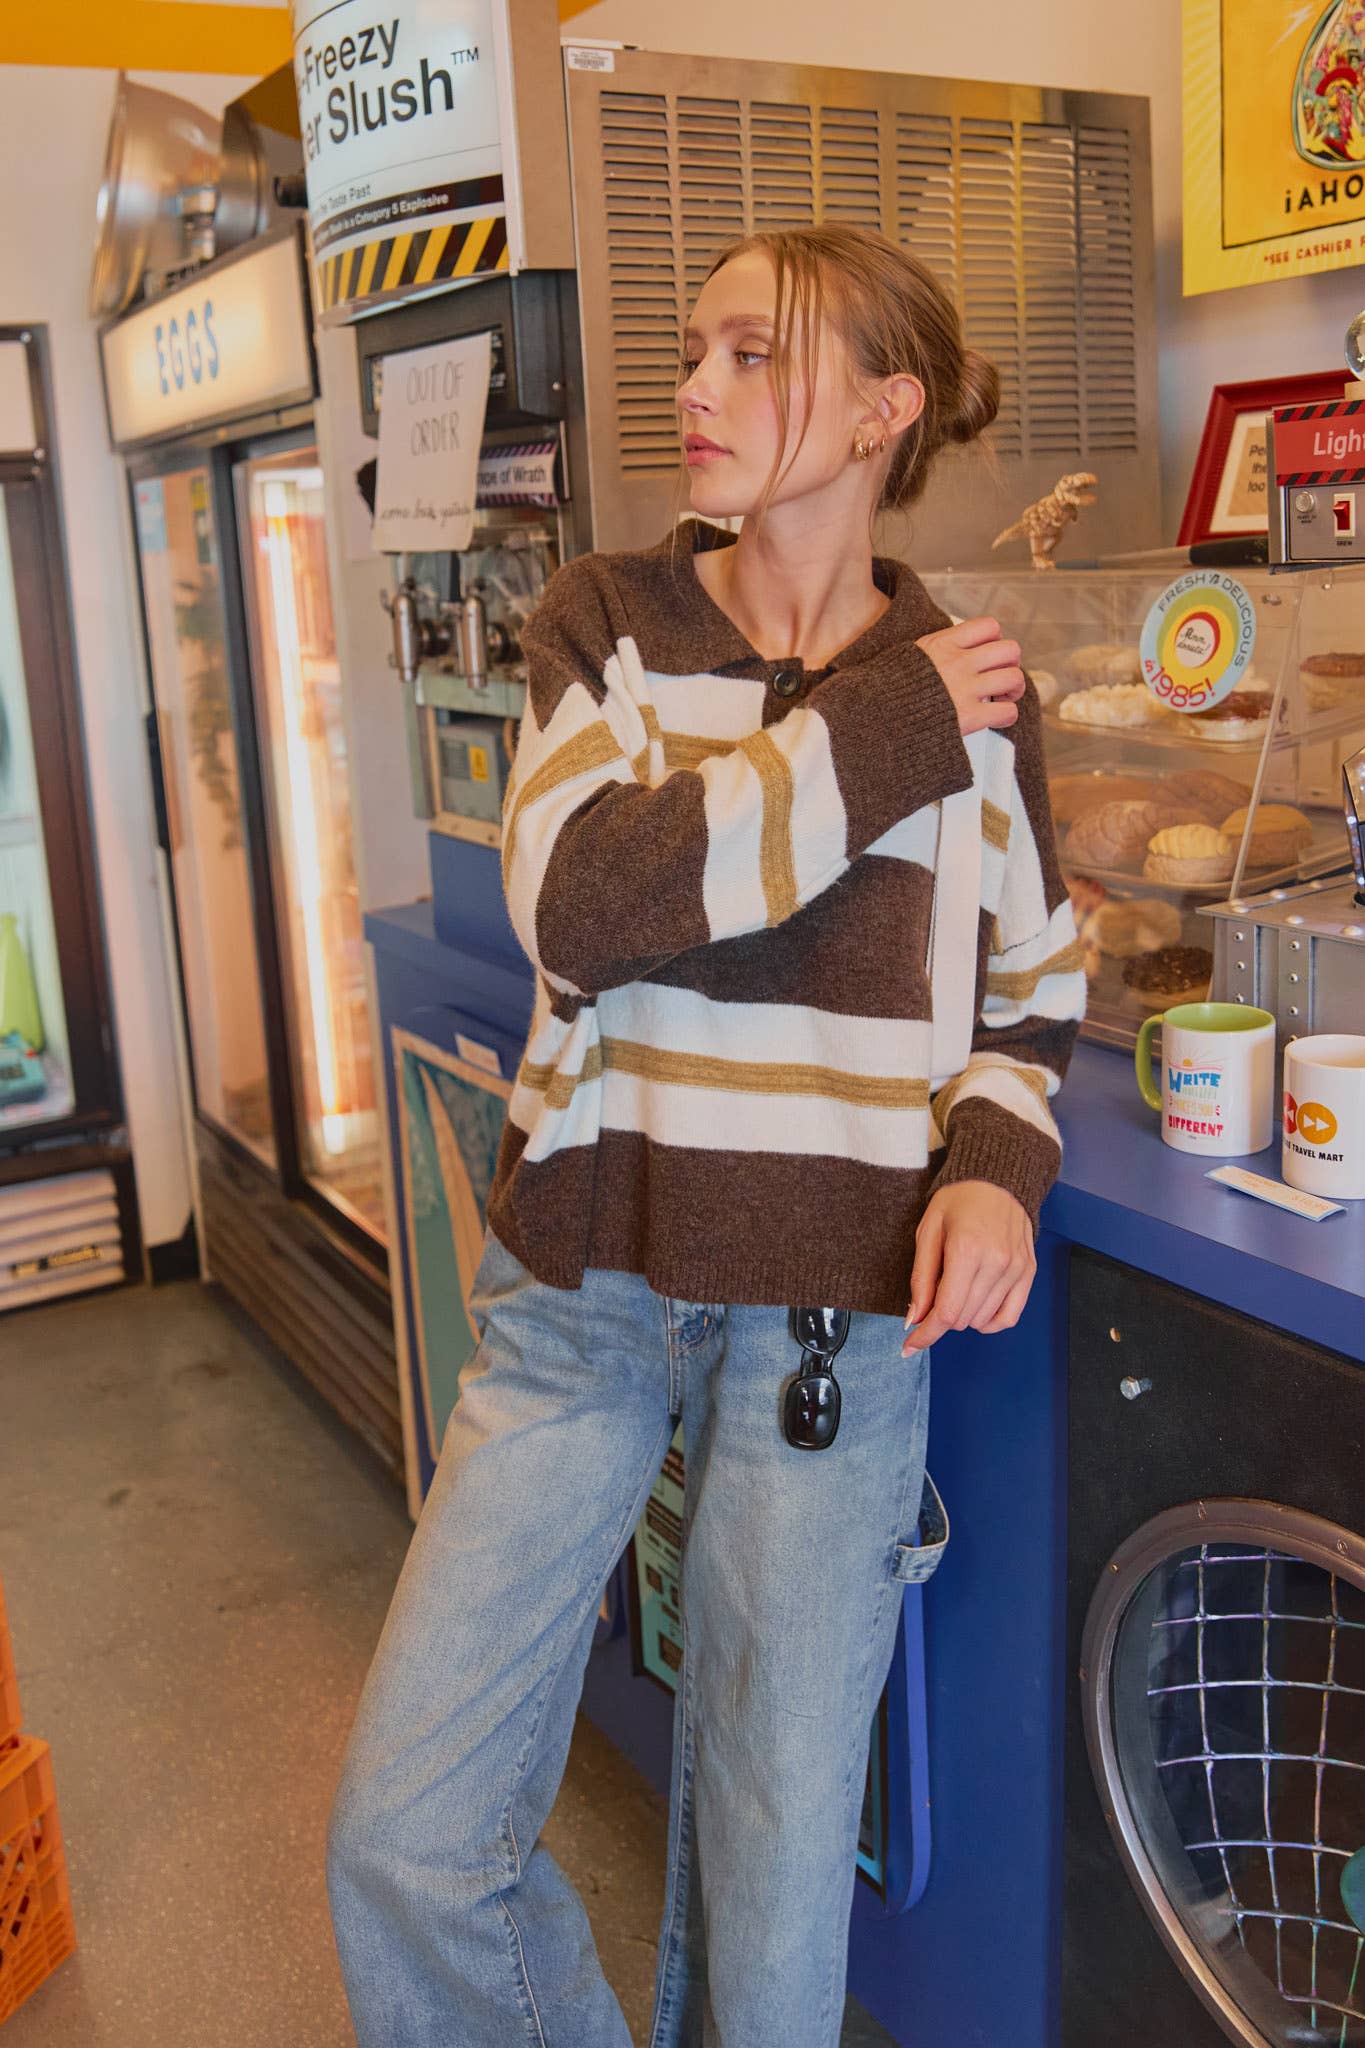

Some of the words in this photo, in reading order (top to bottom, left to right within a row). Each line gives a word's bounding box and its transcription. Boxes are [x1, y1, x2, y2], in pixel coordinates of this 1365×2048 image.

[328, 58, 454, 144] Slush
[392, 203, 399, 215] 5
[400, 193, 449, 212] Explosive
[1296, 239, 1352, 260] CASHIER
[156, 300, 219, 395] EGGS
[407, 362, 440, 405] OUT
[443, 360, 464, 400] OF
[410, 411, 460, 456] ORDER
[513, 465, 545, 483] Wrath
[1158, 574, 1205, 612] FRESH
[1221, 578, 1252, 667] DELICIOUS
[1150, 667, 1215, 708] 1985!
[1168, 1067, 1221, 1093] WRITE
[1168, 1114, 1224, 1137] DIFFERENT
[1292, 1143, 1316, 1158] TRAVEL
[1318, 1151, 1344, 1162] MART
